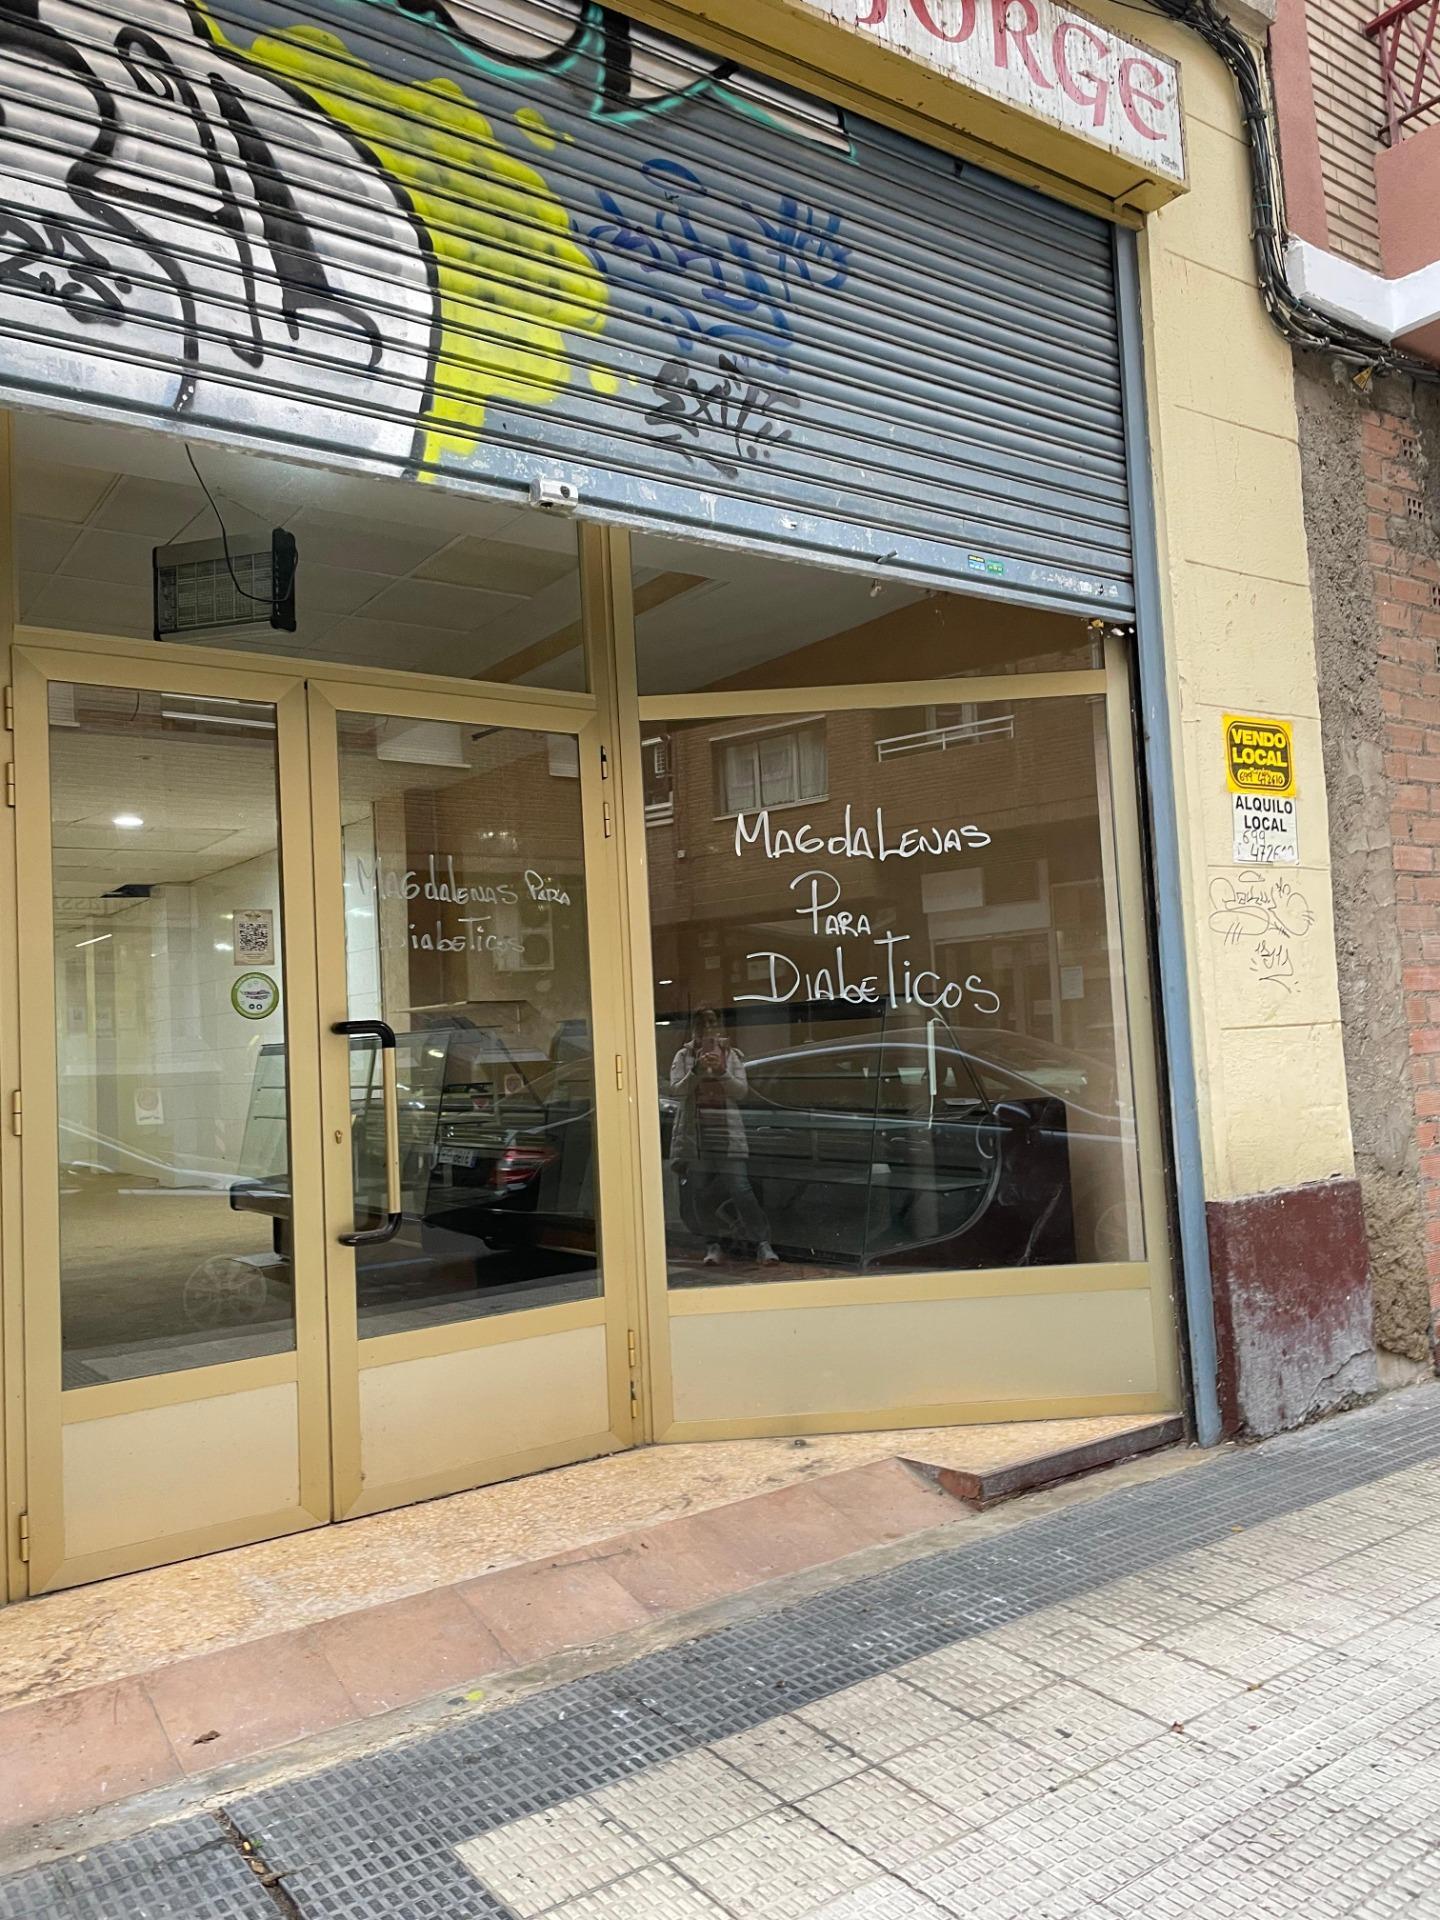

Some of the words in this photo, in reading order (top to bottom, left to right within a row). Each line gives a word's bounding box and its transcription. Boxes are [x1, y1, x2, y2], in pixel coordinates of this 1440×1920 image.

[856, 0, 1167, 141] ORGE
[1231, 728, 1287, 748] VENDO
[1232, 747, 1288, 767] LOCAL
[1235, 795, 1293, 814] ALQUILO
[1244, 815, 1287, 832] LOCAL
[1242, 829, 1266, 845] 699
